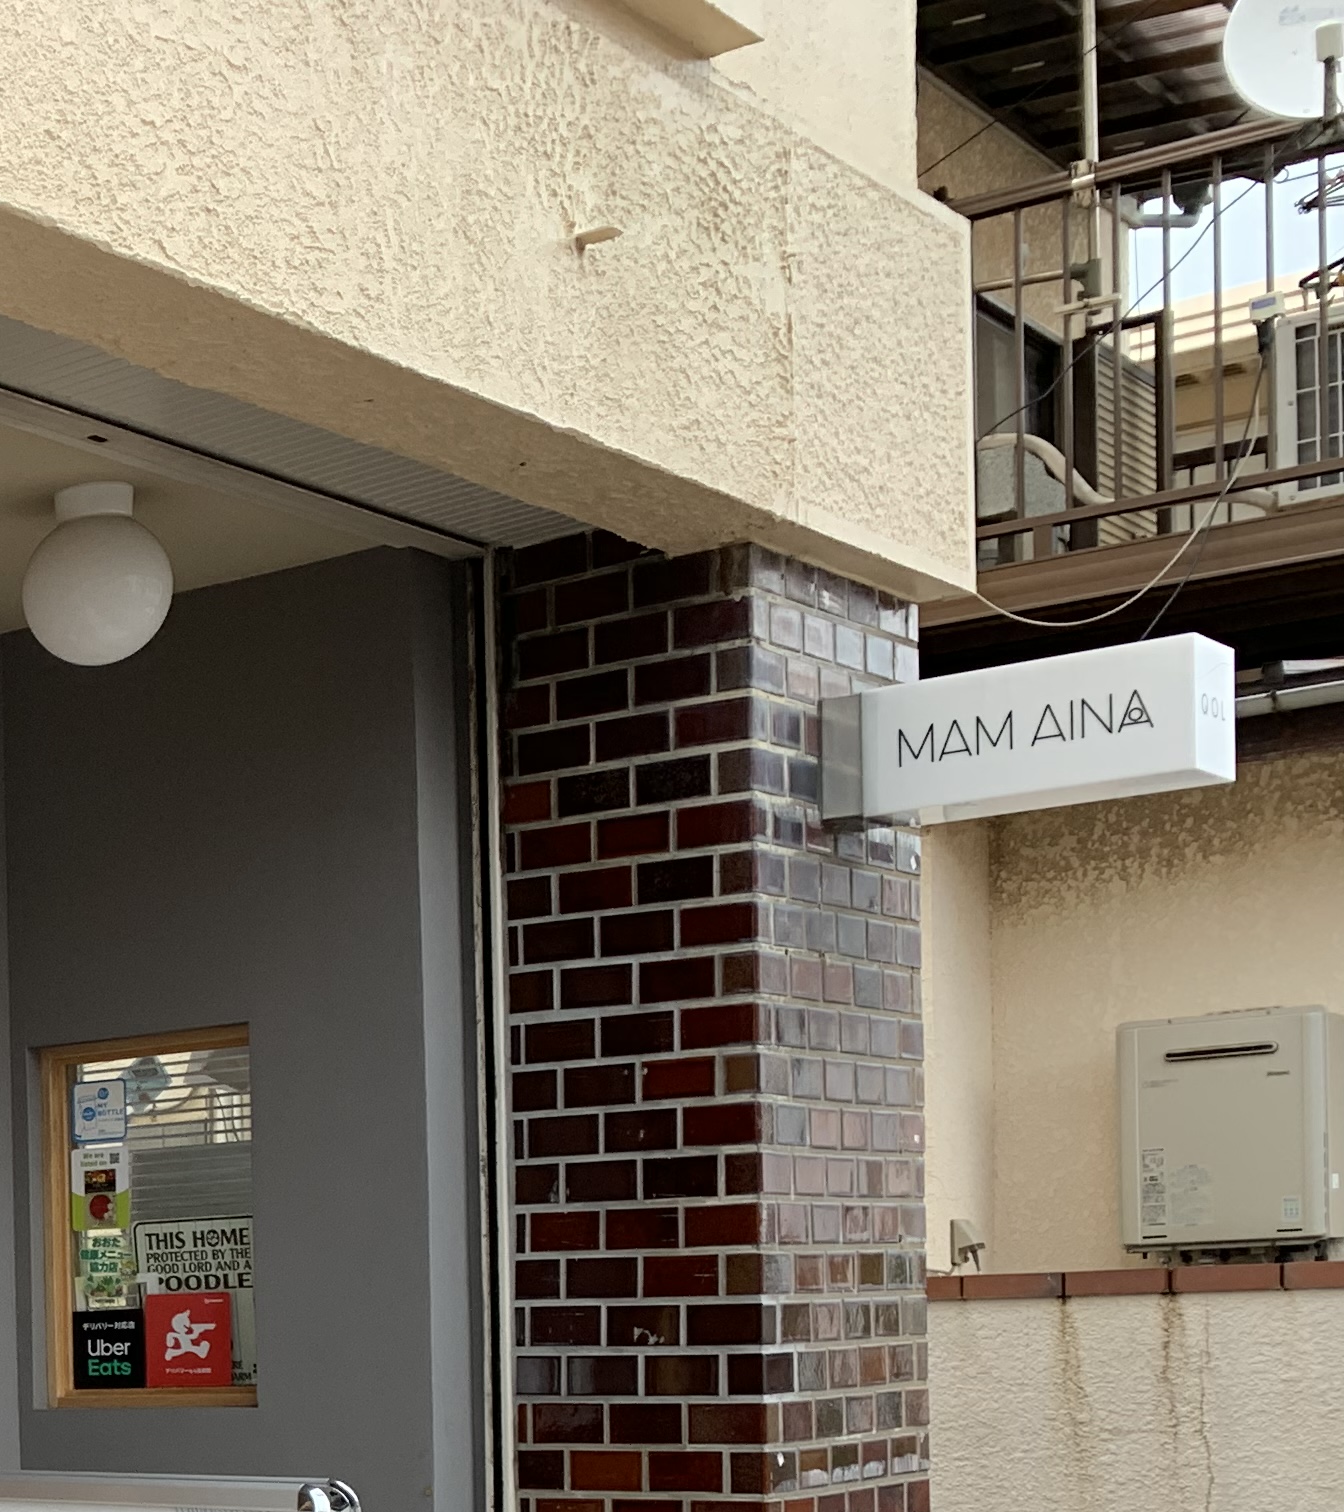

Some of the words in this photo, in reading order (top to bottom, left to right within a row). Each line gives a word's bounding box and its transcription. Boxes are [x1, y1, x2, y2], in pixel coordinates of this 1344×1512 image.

[898, 710, 1013, 767] MAM
[1031, 689, 1154, 747] AINA
[92, 1237, 121, 1248] おおた
[145, 1231, 186, 1250] THIS
[192, 1228, 250, 1248] HOME
[80, 1250, 132, 1260] 健康メニュー
[146, 1250, 208, 1263] PROTECTED
[212, 1249, 227, 1260] BY
[229, 1248, 251, 1259] THE
[147, 1262, 179, 1274] GOOD
[183, 1261, 212, 1273] LORD
[216, 1260, 240, 1271] AND
[244, 1260, 252, 1270] A
[158, 1272, 253, 1291] OODLE
[87, 1339, 131, 1357] Uber
[88, 1359, 132, 1376] Eats
